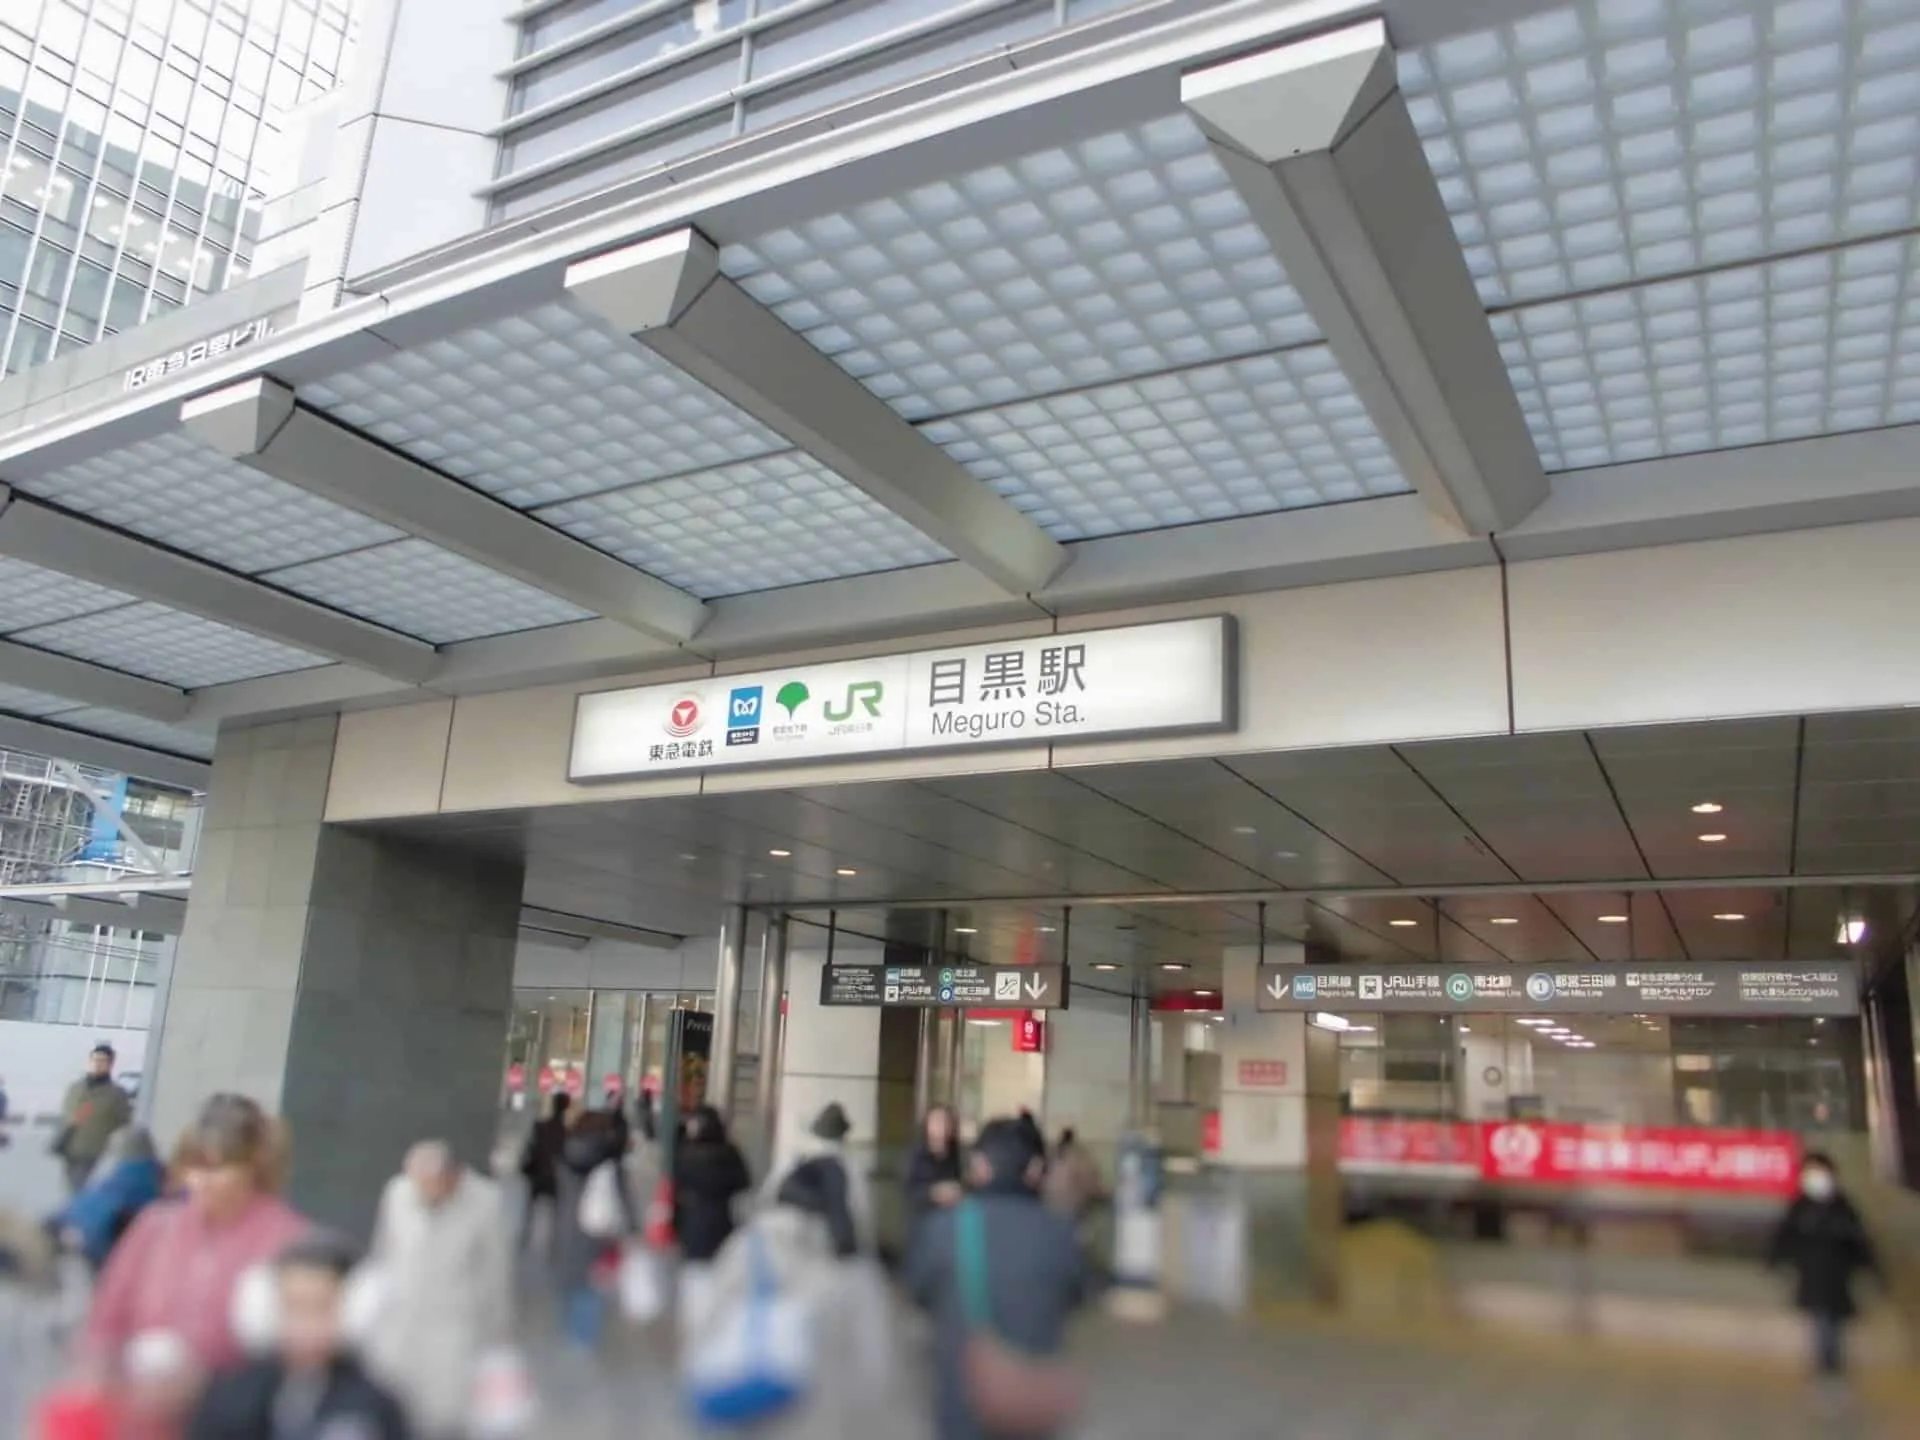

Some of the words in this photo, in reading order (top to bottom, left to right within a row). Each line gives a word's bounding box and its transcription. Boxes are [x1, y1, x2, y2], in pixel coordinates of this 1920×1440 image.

[930, 644, 1088, 707] 目黒駅
[823, 680, 884, 721] JR
[931, 705, 1026, 741] Meguro
[1034, 698, 1087, 728] Sta.
[648, 739, 714, 763] 東急電鉄
[1384, 975, 1440, 989] JR山手線
